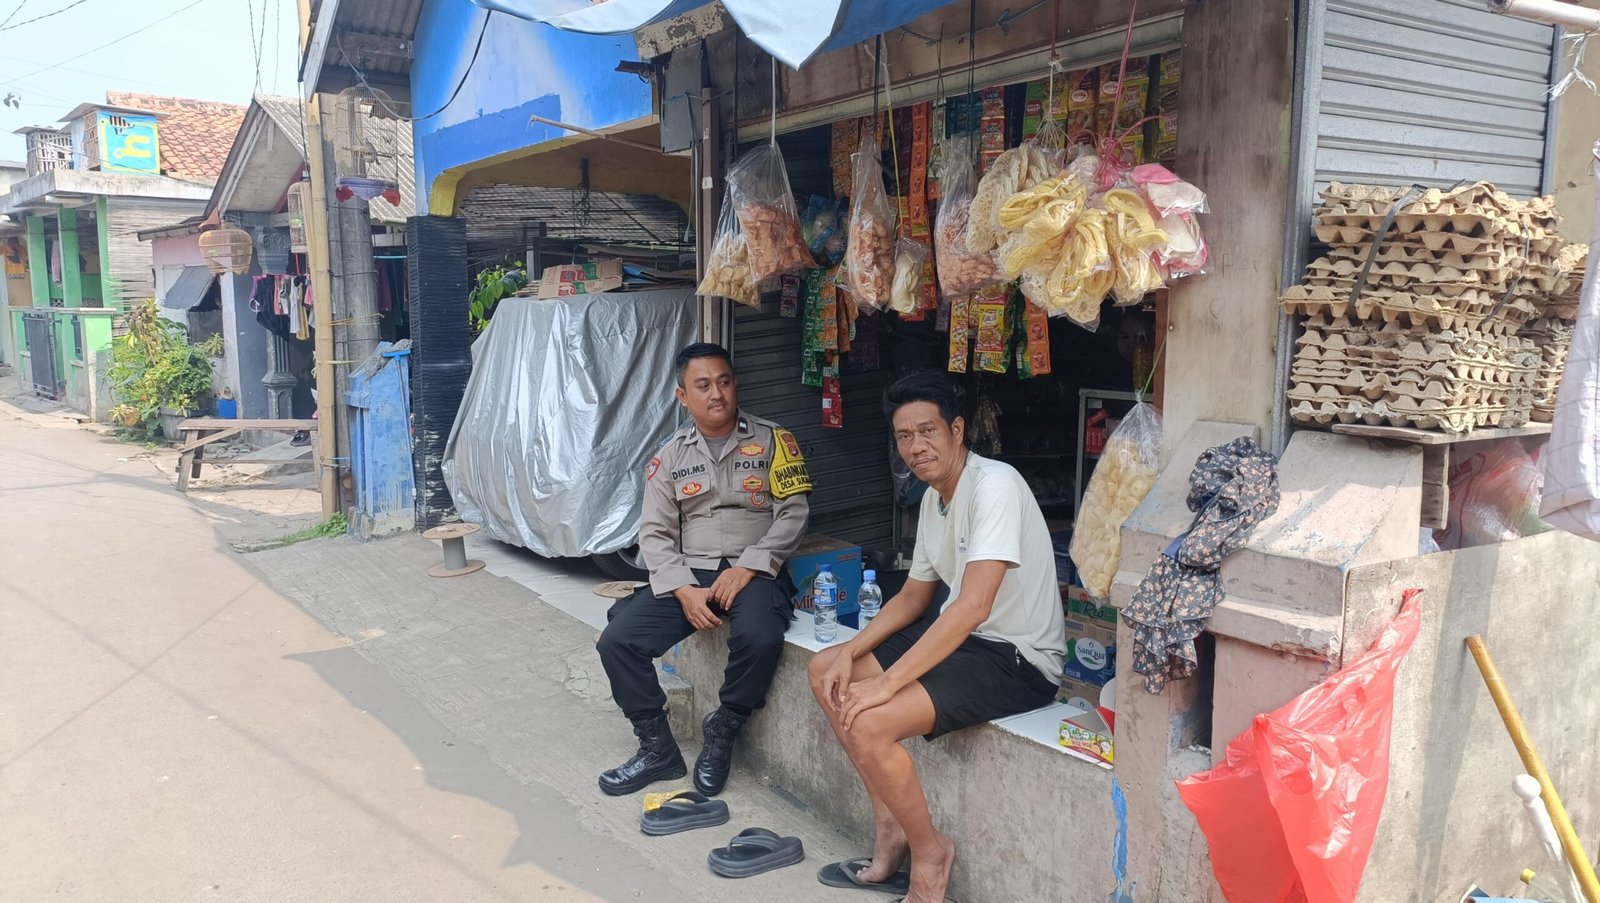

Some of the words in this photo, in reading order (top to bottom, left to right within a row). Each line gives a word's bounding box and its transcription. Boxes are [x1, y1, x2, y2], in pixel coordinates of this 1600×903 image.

[672, 464, 706, 480] DIDI.MS
[735, 460, 769, 470] POLRI
[1077, 646, 1105, 660] SanQua
